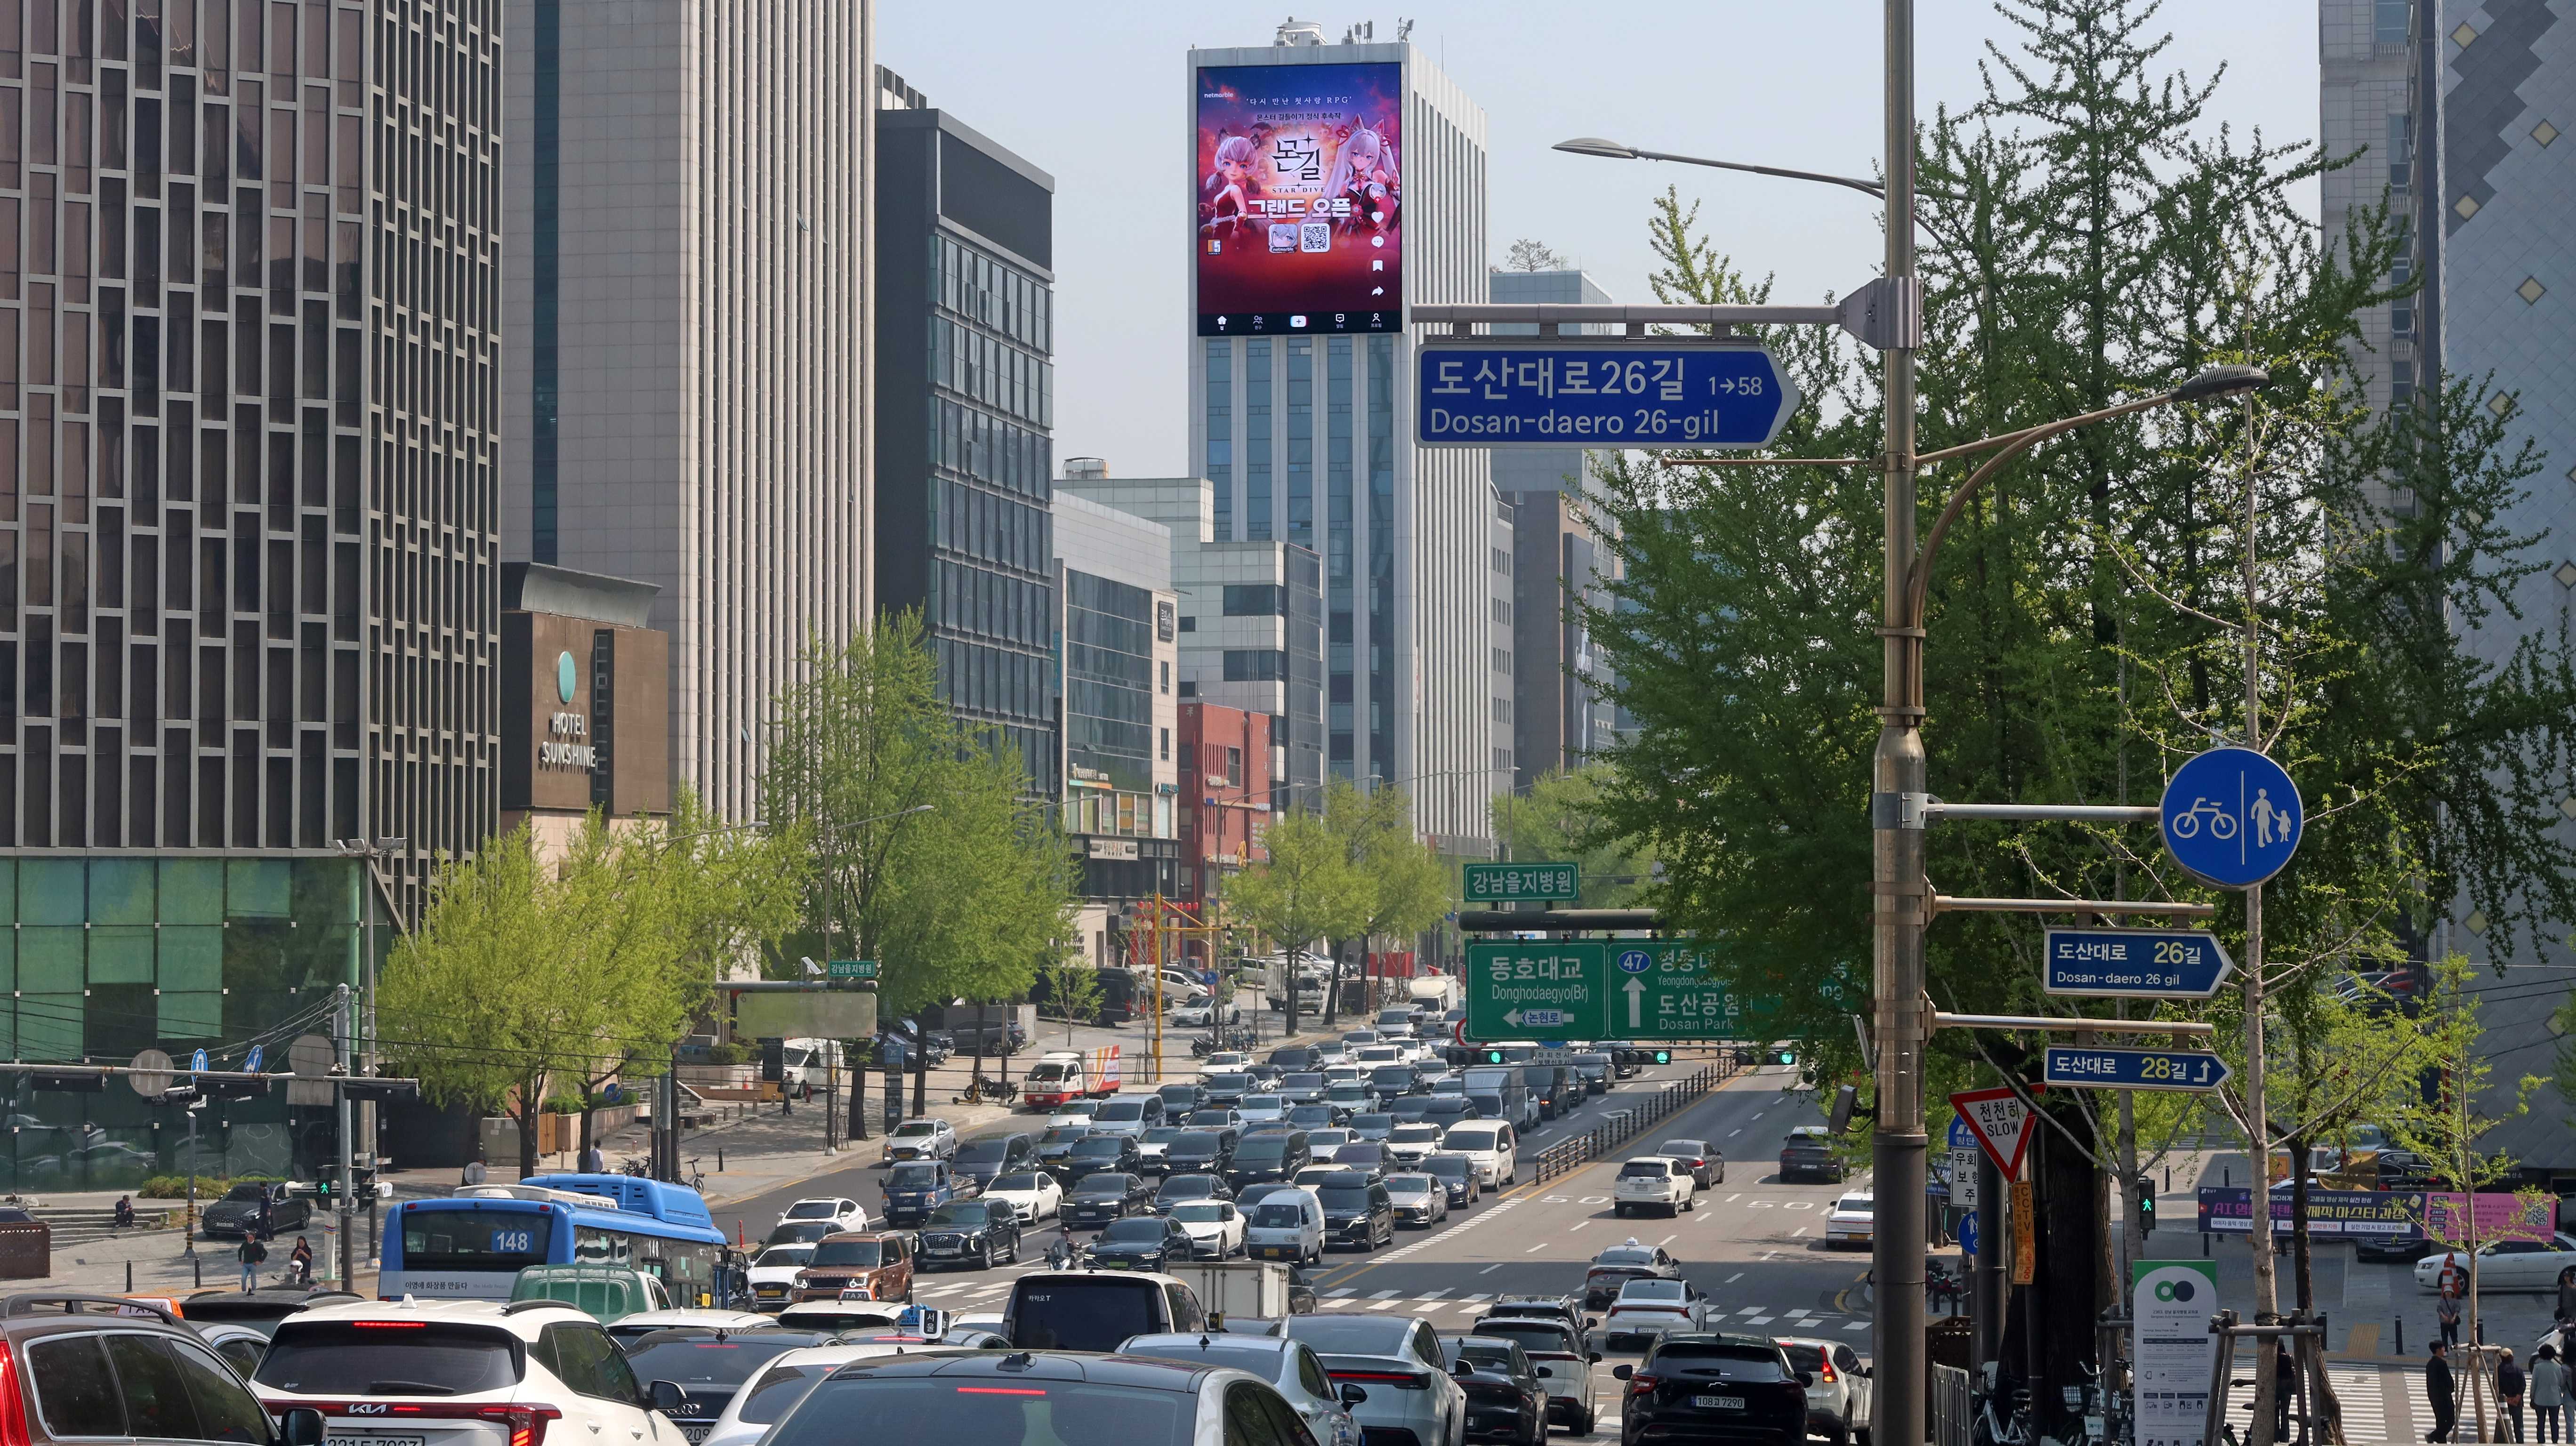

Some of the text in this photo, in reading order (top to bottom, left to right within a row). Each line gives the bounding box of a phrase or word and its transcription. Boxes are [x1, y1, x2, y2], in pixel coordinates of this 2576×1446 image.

[1295, 97, 1321, 105] 첫사랑
[1306, 112, 1319, 120] 정식
[1321, 112, 1341, 120] 후속작
[1247, 198, 1351, 219] 그랜드 오픈
[1431, 357, 1684, 401] 도산대로26길
[1431, 409, 1719, 441] Dosan-daero 26-gil
[552, 711, 587, 736] HOTEL
[542, 741, 596, 768] SUNSHINE
[1473, 870, 1571, 894] 강남을지병원
[1623, 954, 1644, 970] 47
[2057, 941, 2201, 964] 도산대로 26길
[831, 964, 872, 973] 강남을지병원
[1489, 956, 1583, 980] 동호대교
[2146, 973, 2160, 985] 26
[2165, 974, 2180, 986] gil
[1492, 984, 1588, 1003] Donghodaegyo(Br)
[1658, 993, 1739, 1016] 도산공원
[1528, 1012, 1559, 1024] 논현로
[1659, 1018, 1734, 1030] Dosan Park
[2055, 1056, 2186, 1080] 도산대로 28길
[1980, 1099, 2020, 1123] 천천히
[1987, 1121, 2019, 1137] SLOW
[1747, 1201, 1814, 1209] 50
[2021, 1187, 2031, 1231] CCTV
[2213, 1203, 2232, 1215] AI
[2269, 1205, 2293, 1216] 콘텐
[2308, 1205, 2334, 1218] 제작
[2336, 1206, 2376, 1219] 마스터
[2379, 1207, 2406, 1220] 과정
[497, 1232, 528, 1251] 148
[649, 1239, 659, 1258] 148
[405, 1281, 424, 1289] 이영애
[426, 1281, 446, 1290] 화장품
[448, 1281, 467, 1290] 만들다
[927, 1313, 935, 1332] 서울
[1722, 1398, 1743, 1407] 7290
